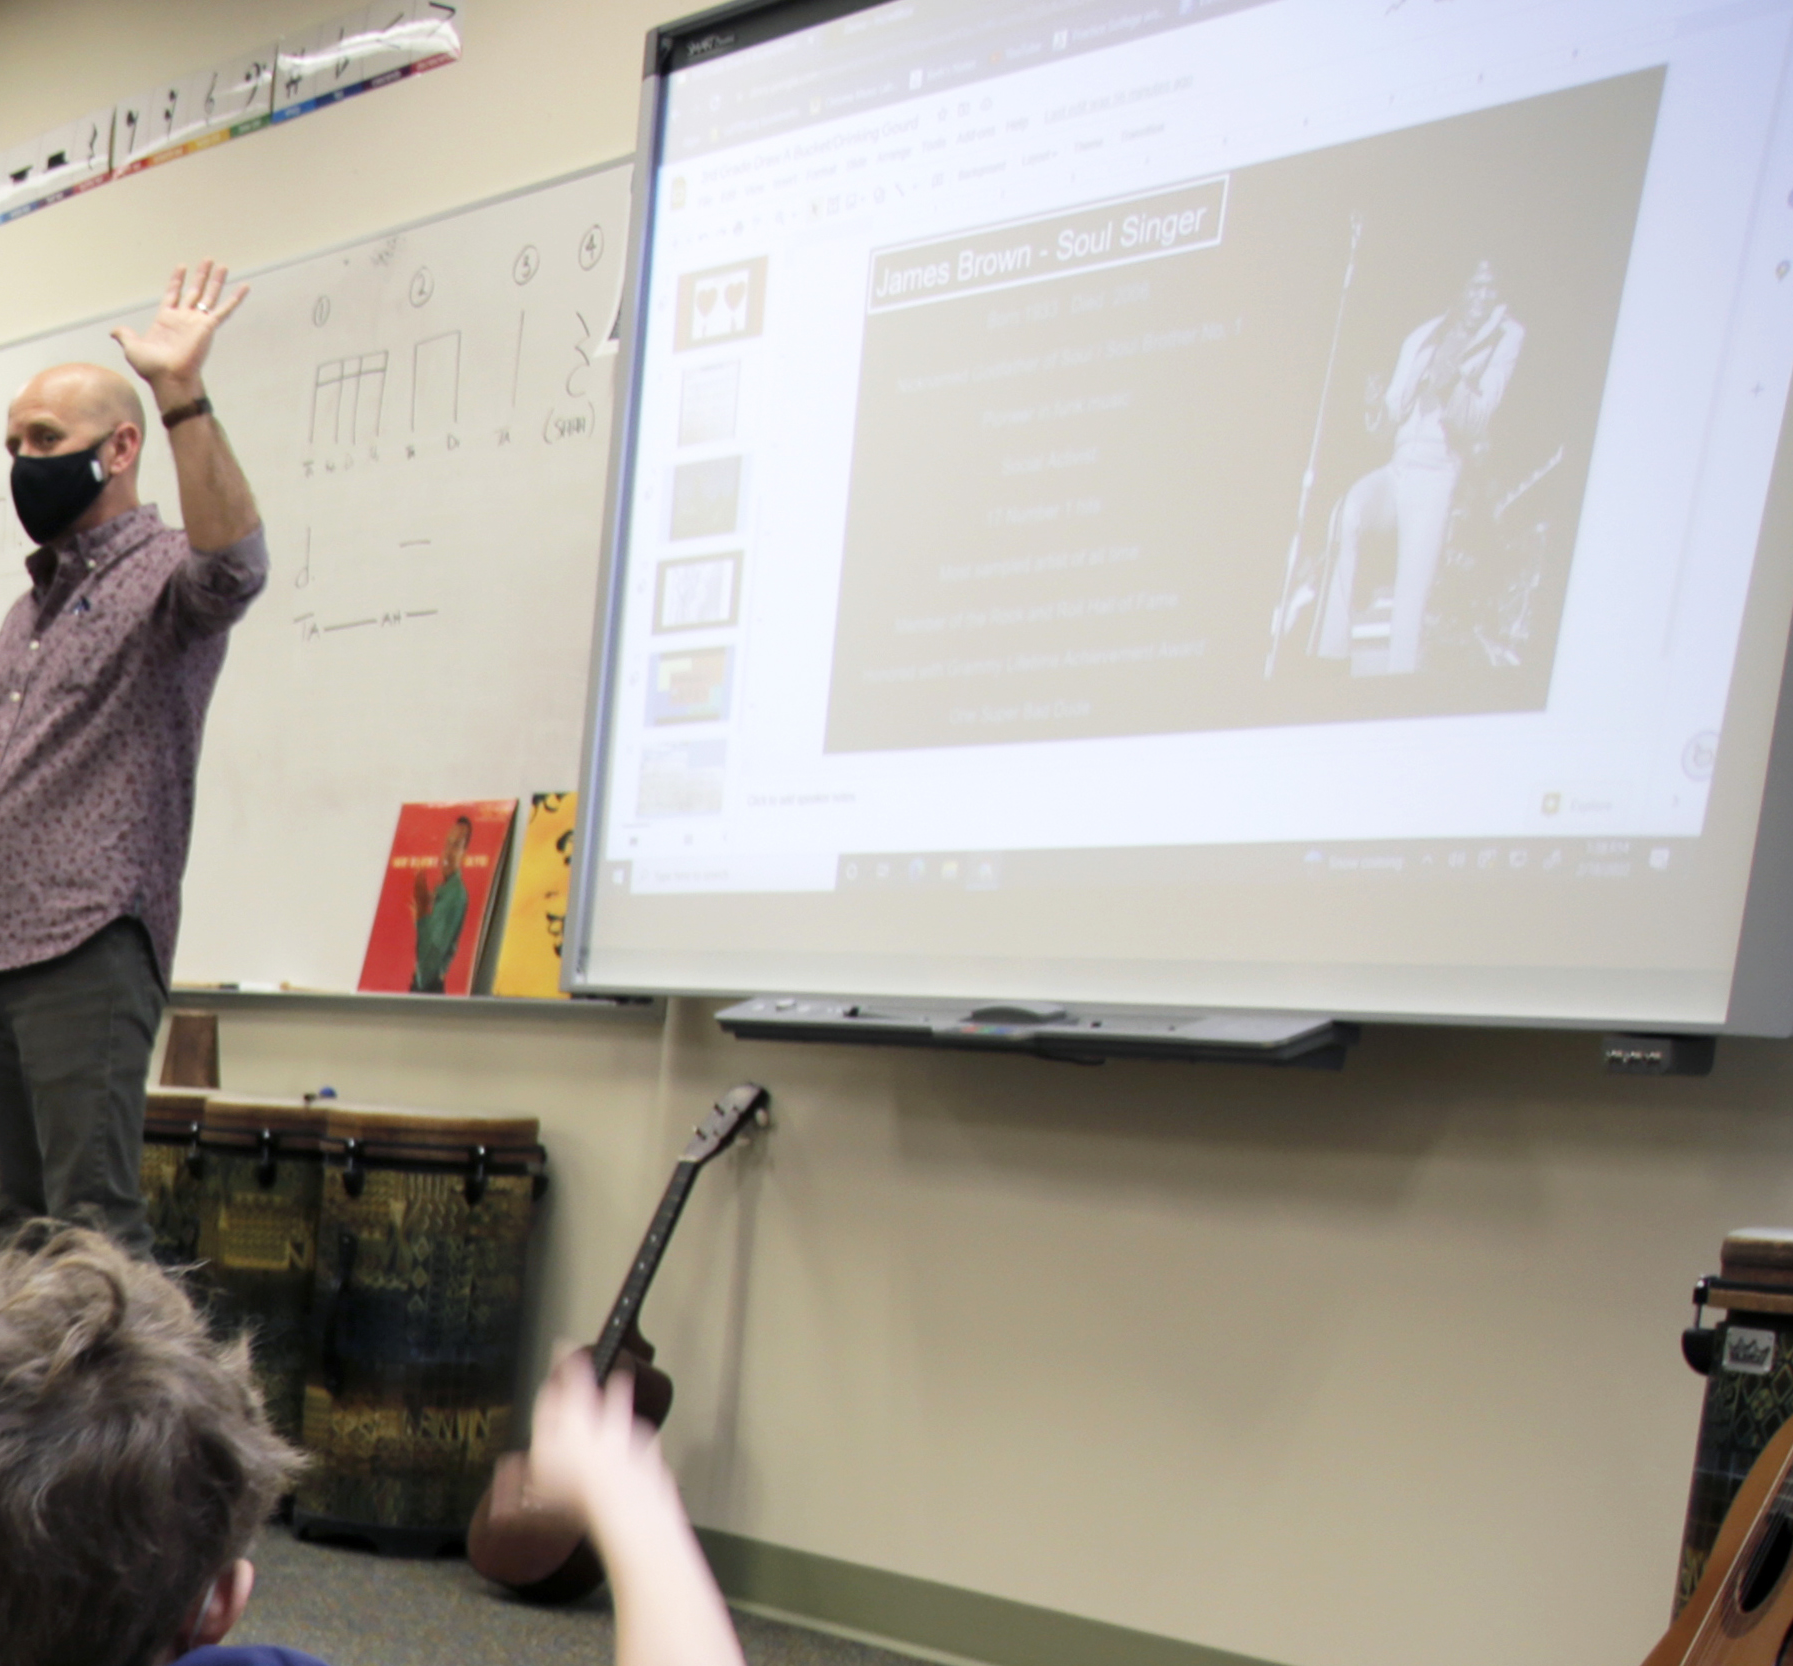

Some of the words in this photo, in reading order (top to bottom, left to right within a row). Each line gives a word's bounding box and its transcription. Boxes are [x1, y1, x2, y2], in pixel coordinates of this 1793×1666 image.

[882, 114, 919, 138] Gourd
[876, 267, 950, 298] James
[957, 244, 1032, 282] Brown
[1056, 220, 1113, 261] Soul
[1120, 206, 1208, 248] Singer
[1042, 350, 1058, 371] of
[1001, 454, 1044, 477] Social
[1005, 504, 1060, 524] Number
[939, 563, 972, 582] Most
[1070, 548, 1086, 568] of
[948, 611, 963, 630] of
[989, 606, 1024, 627] Rock
[1026, 603, 1053, 622] and
[1056, 599, 1084, 619] Roll
[1087, 597, 1115, 616] Hall
[1117, 593, 1133, 614] of
[1135, 591, 1179, 612] Fame
[1062, 645, 1154, 669] Achievement
[1157, 640, 1205, 661] Award
[949, 706, 977, 726] One
[980, 703, 1020, 726] Super
[1023, 700, 1050, 721] Bad
